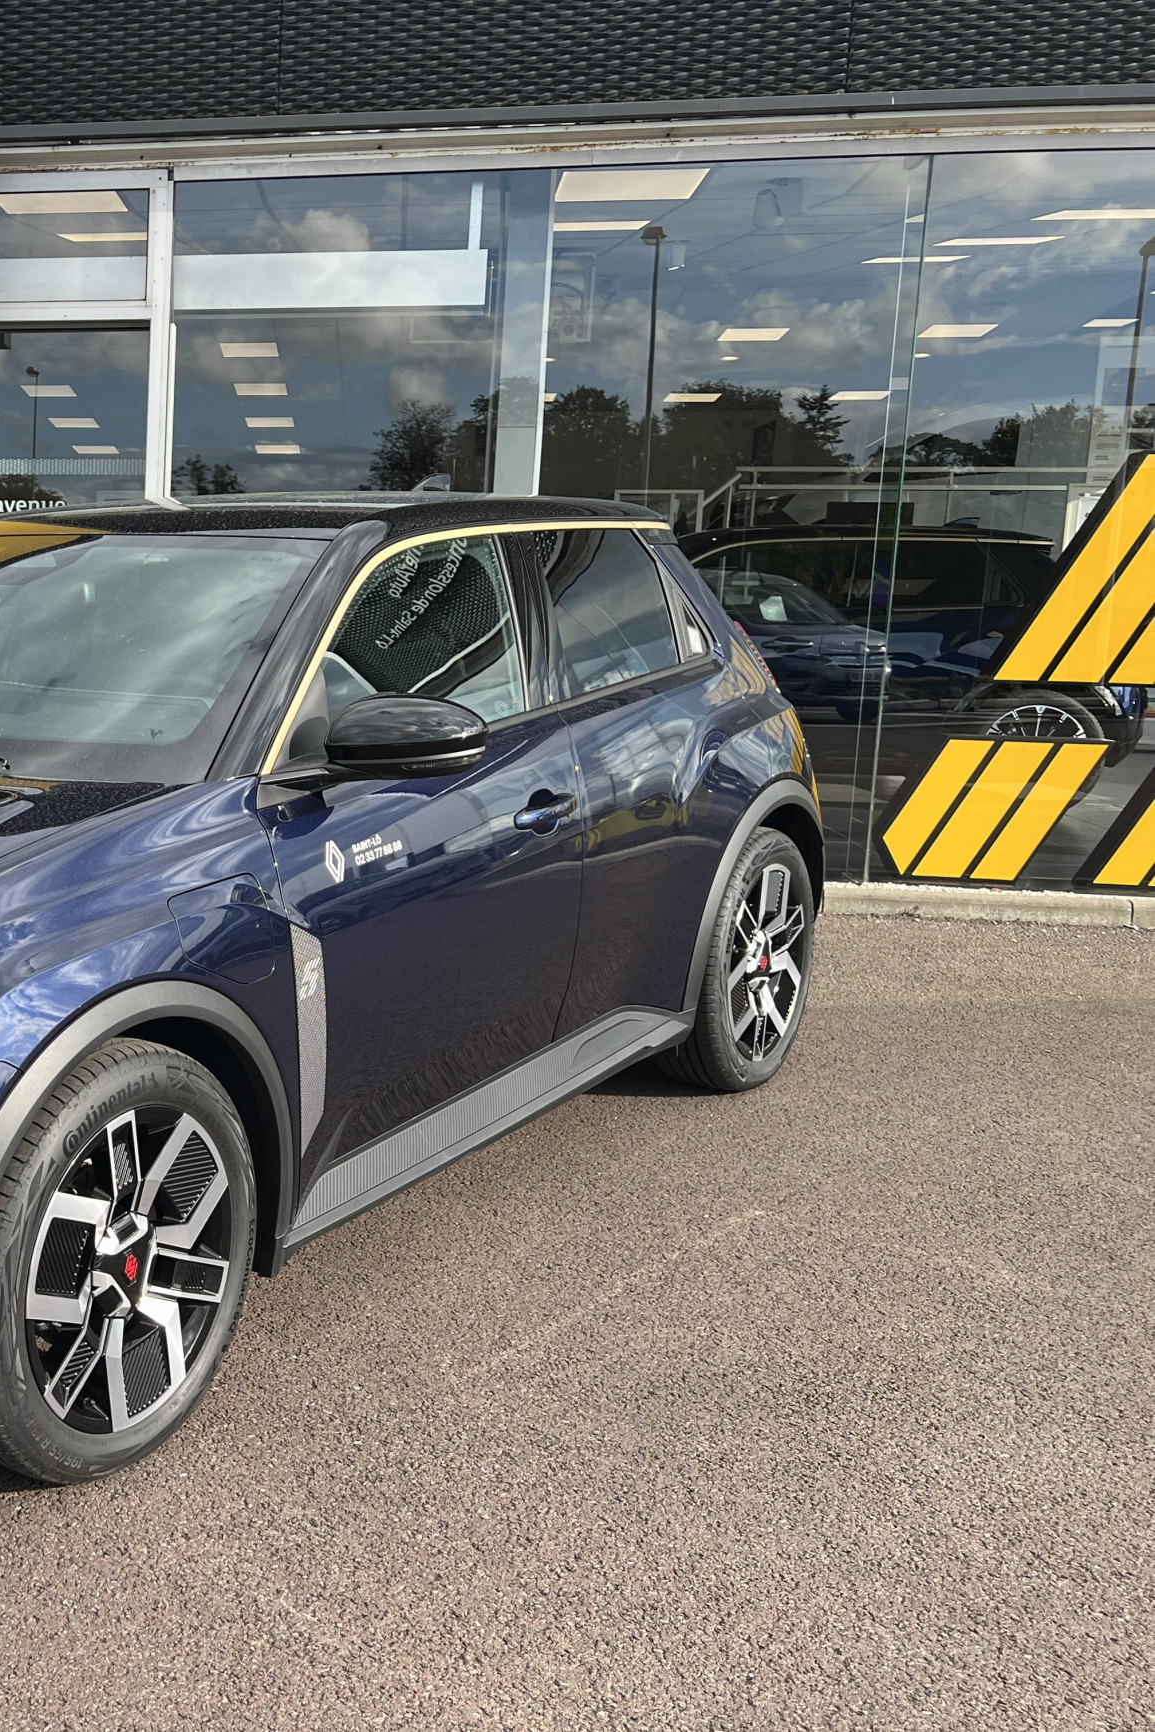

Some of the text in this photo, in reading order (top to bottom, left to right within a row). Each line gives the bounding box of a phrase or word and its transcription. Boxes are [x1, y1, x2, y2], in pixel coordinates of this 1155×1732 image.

[354, 840, 403, 866] 02 33 77 88 88
[62, 1074, 146, 1158] Continental
[40, 1438, 52, 1450] R
[48, 1444, 84, 1470] 195/55
